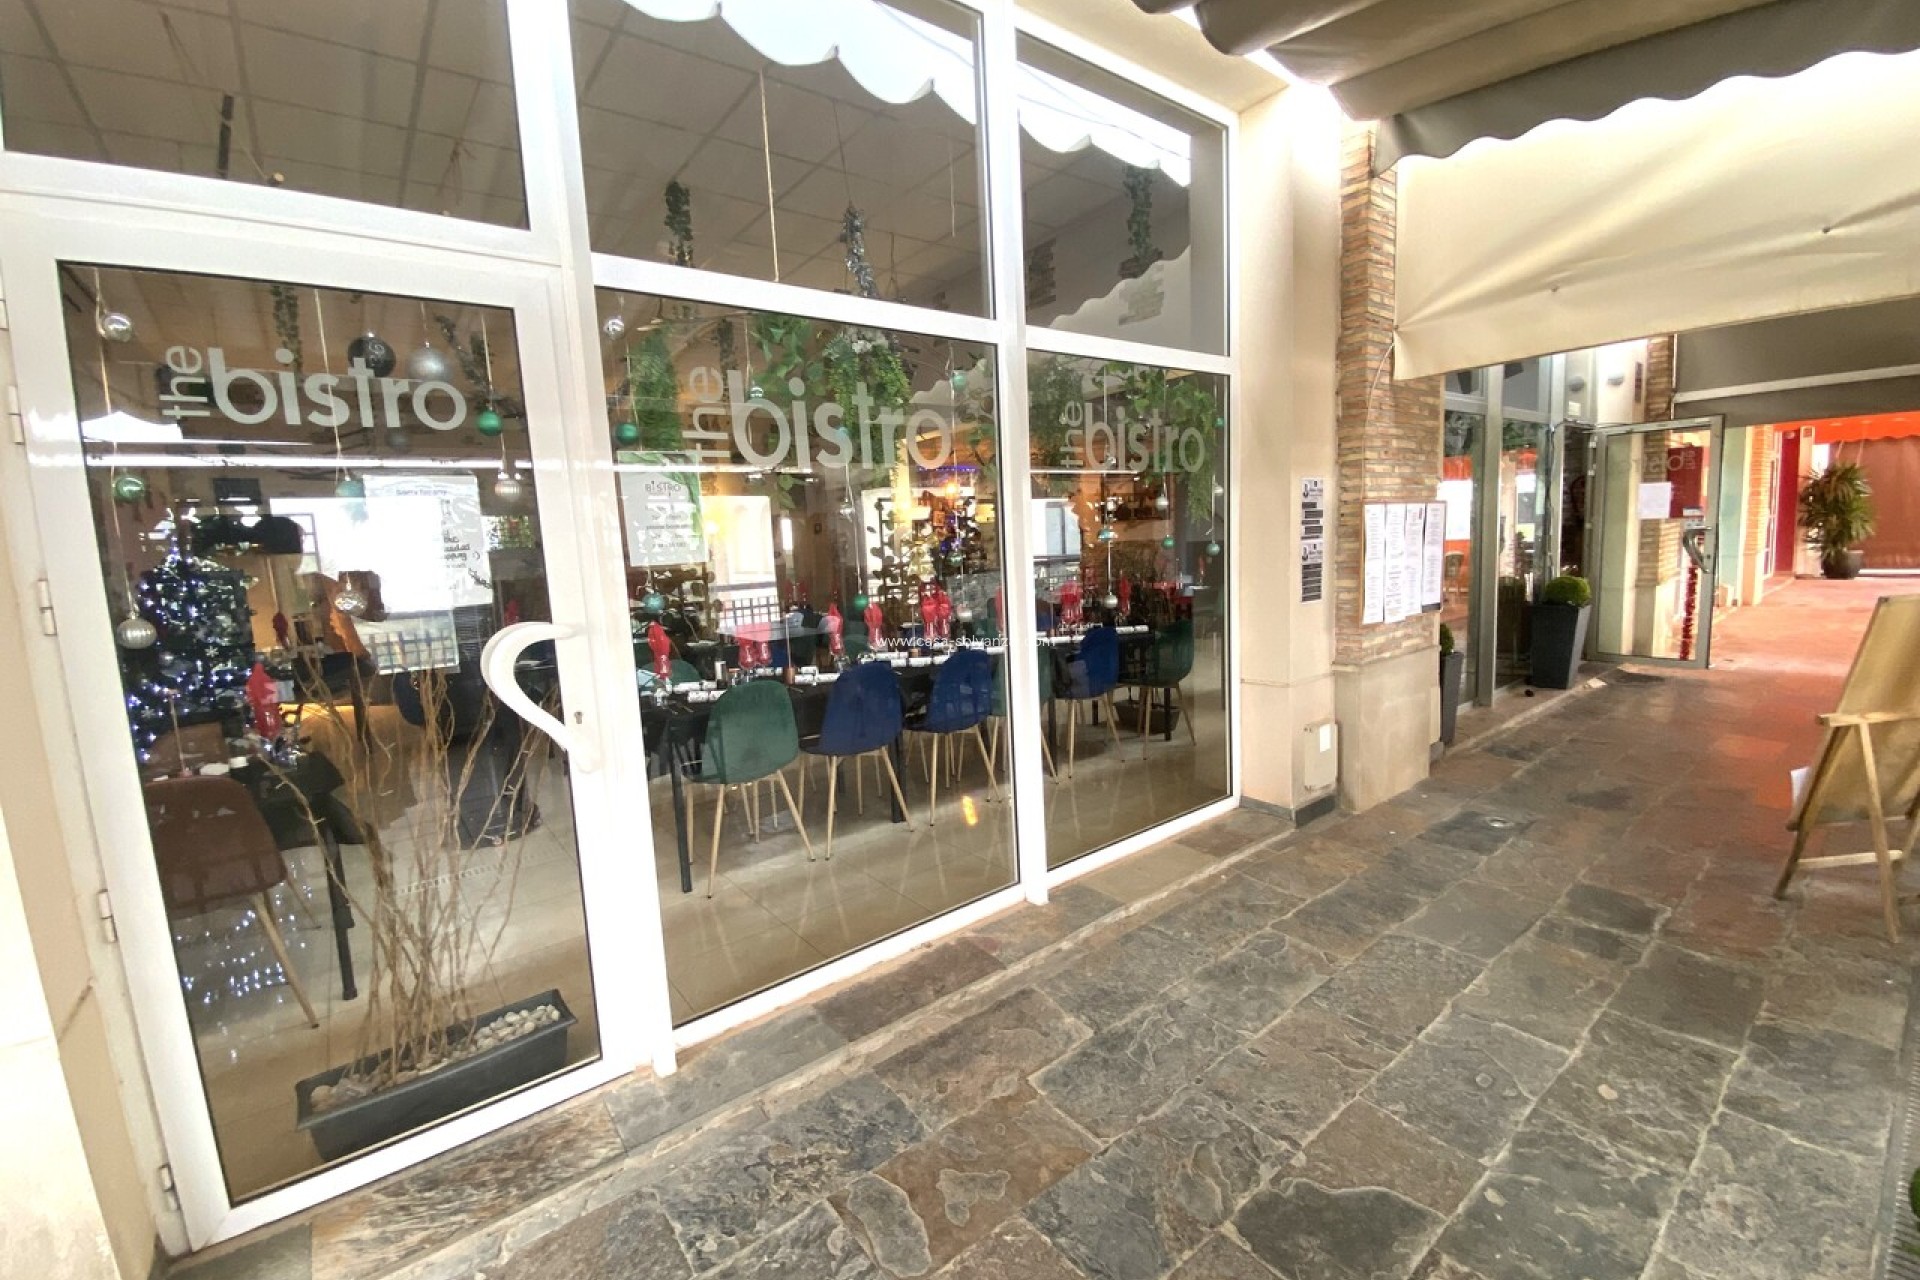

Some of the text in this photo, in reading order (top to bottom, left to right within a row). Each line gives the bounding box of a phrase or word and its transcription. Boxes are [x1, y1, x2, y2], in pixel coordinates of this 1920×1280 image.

[159, 345, 467, 431] the bistro
[682, 366, 951, 470] the bistro
[1059, 400, 1206, 473] the bistro
